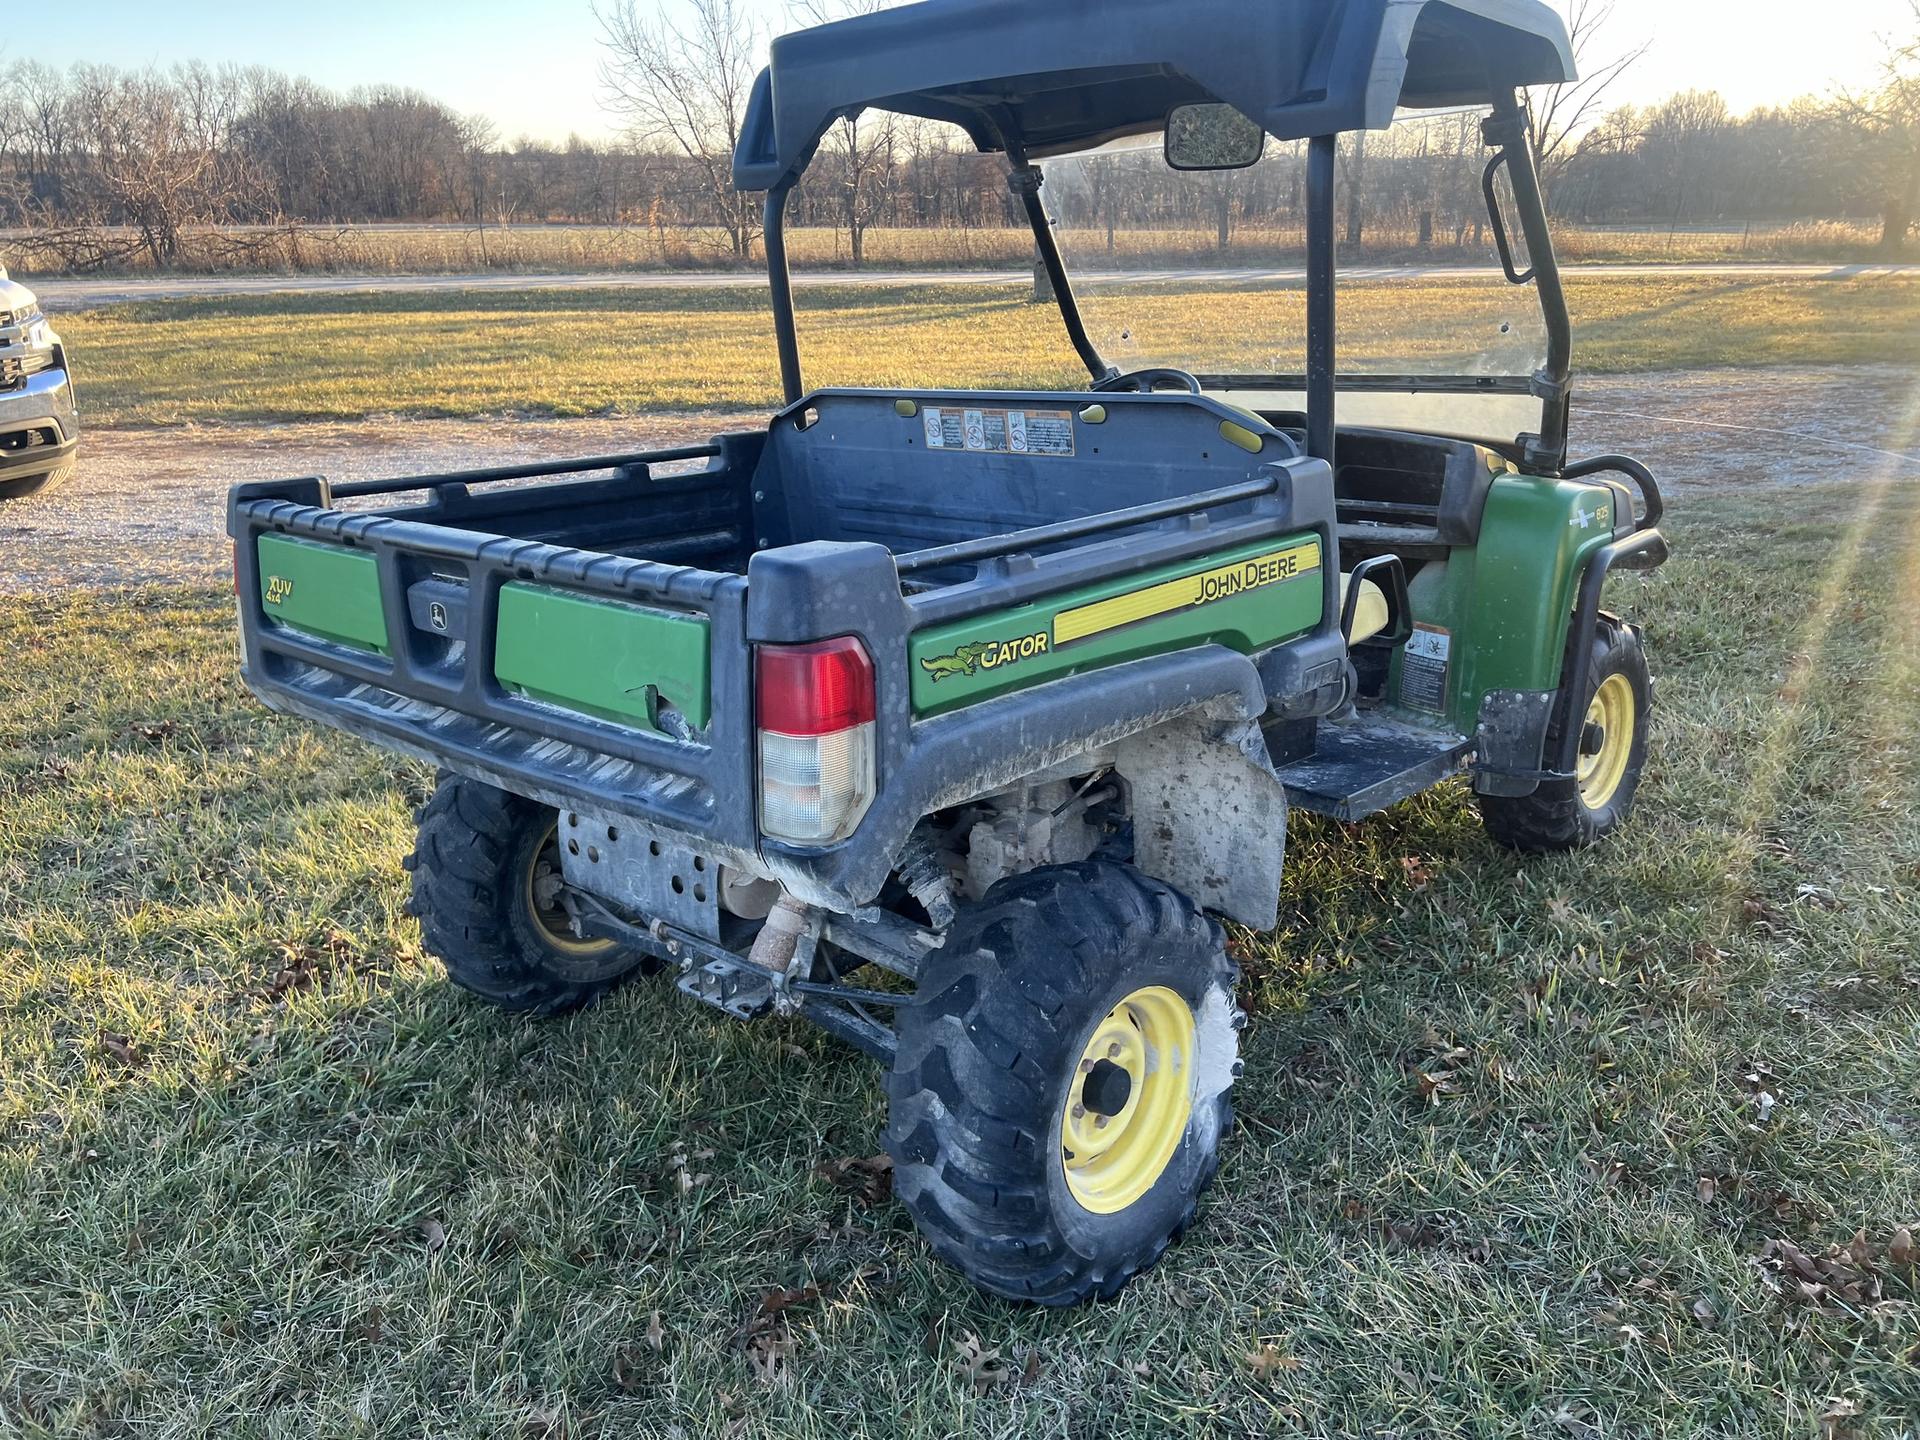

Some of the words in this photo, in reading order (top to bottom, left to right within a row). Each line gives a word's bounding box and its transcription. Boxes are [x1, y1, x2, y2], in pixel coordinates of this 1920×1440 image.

[268, 576, 292, 596] XUV
[1194, 569, 1242, 604] JOHN
[1244, 554, 1298, 589] DEERE
[265, 590, 281, 605] 4x4
[980, 631, 1048, 669] GATOR
